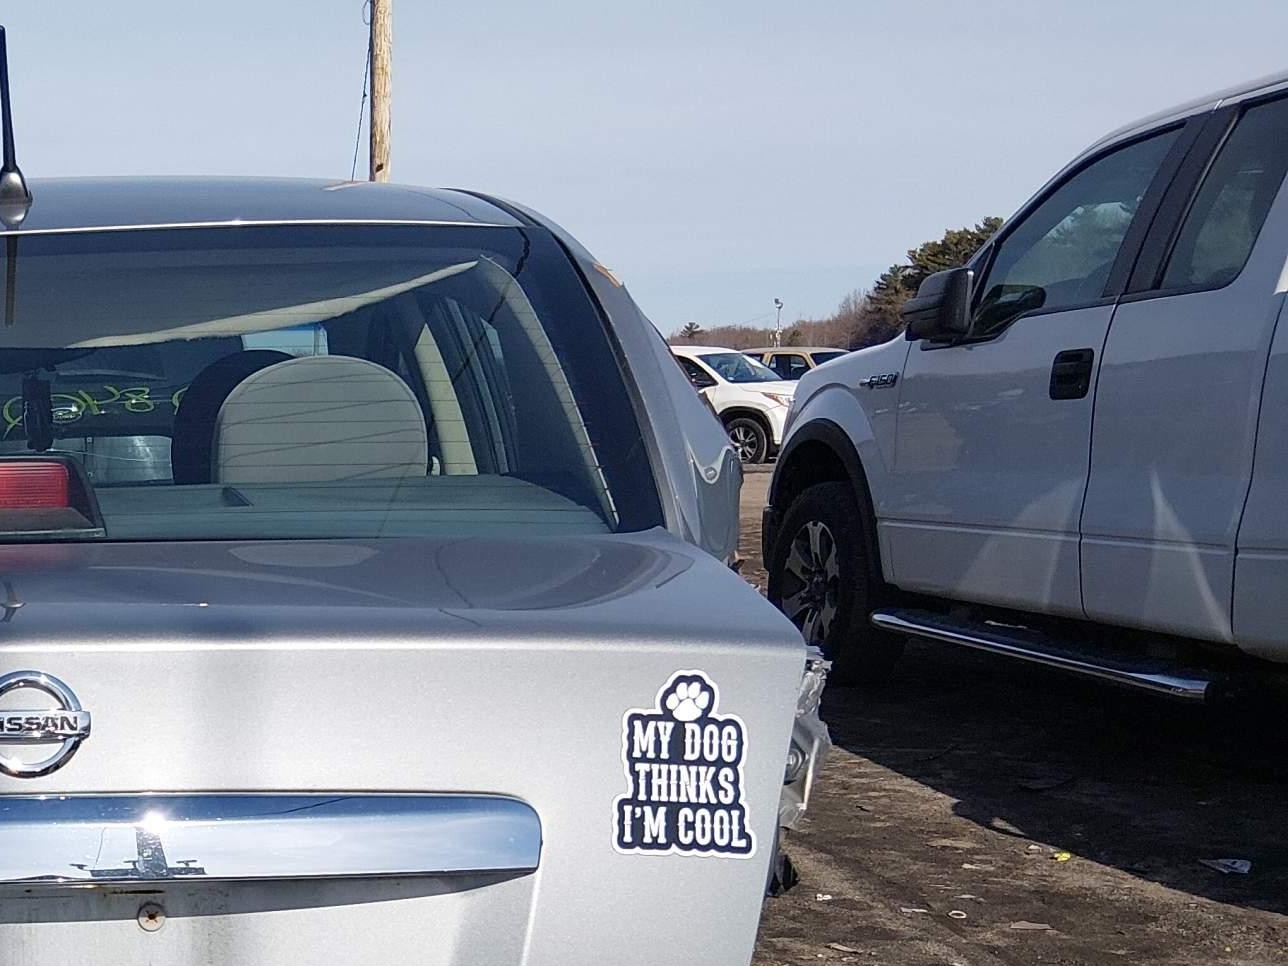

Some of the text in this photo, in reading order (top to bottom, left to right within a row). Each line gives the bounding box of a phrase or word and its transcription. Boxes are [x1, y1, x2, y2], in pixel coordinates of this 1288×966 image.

[632, 720, 738, 763] MY DOG
[634, 762, 735, 805] THINKS
[623, 805, 748, 848] I'M COOL
